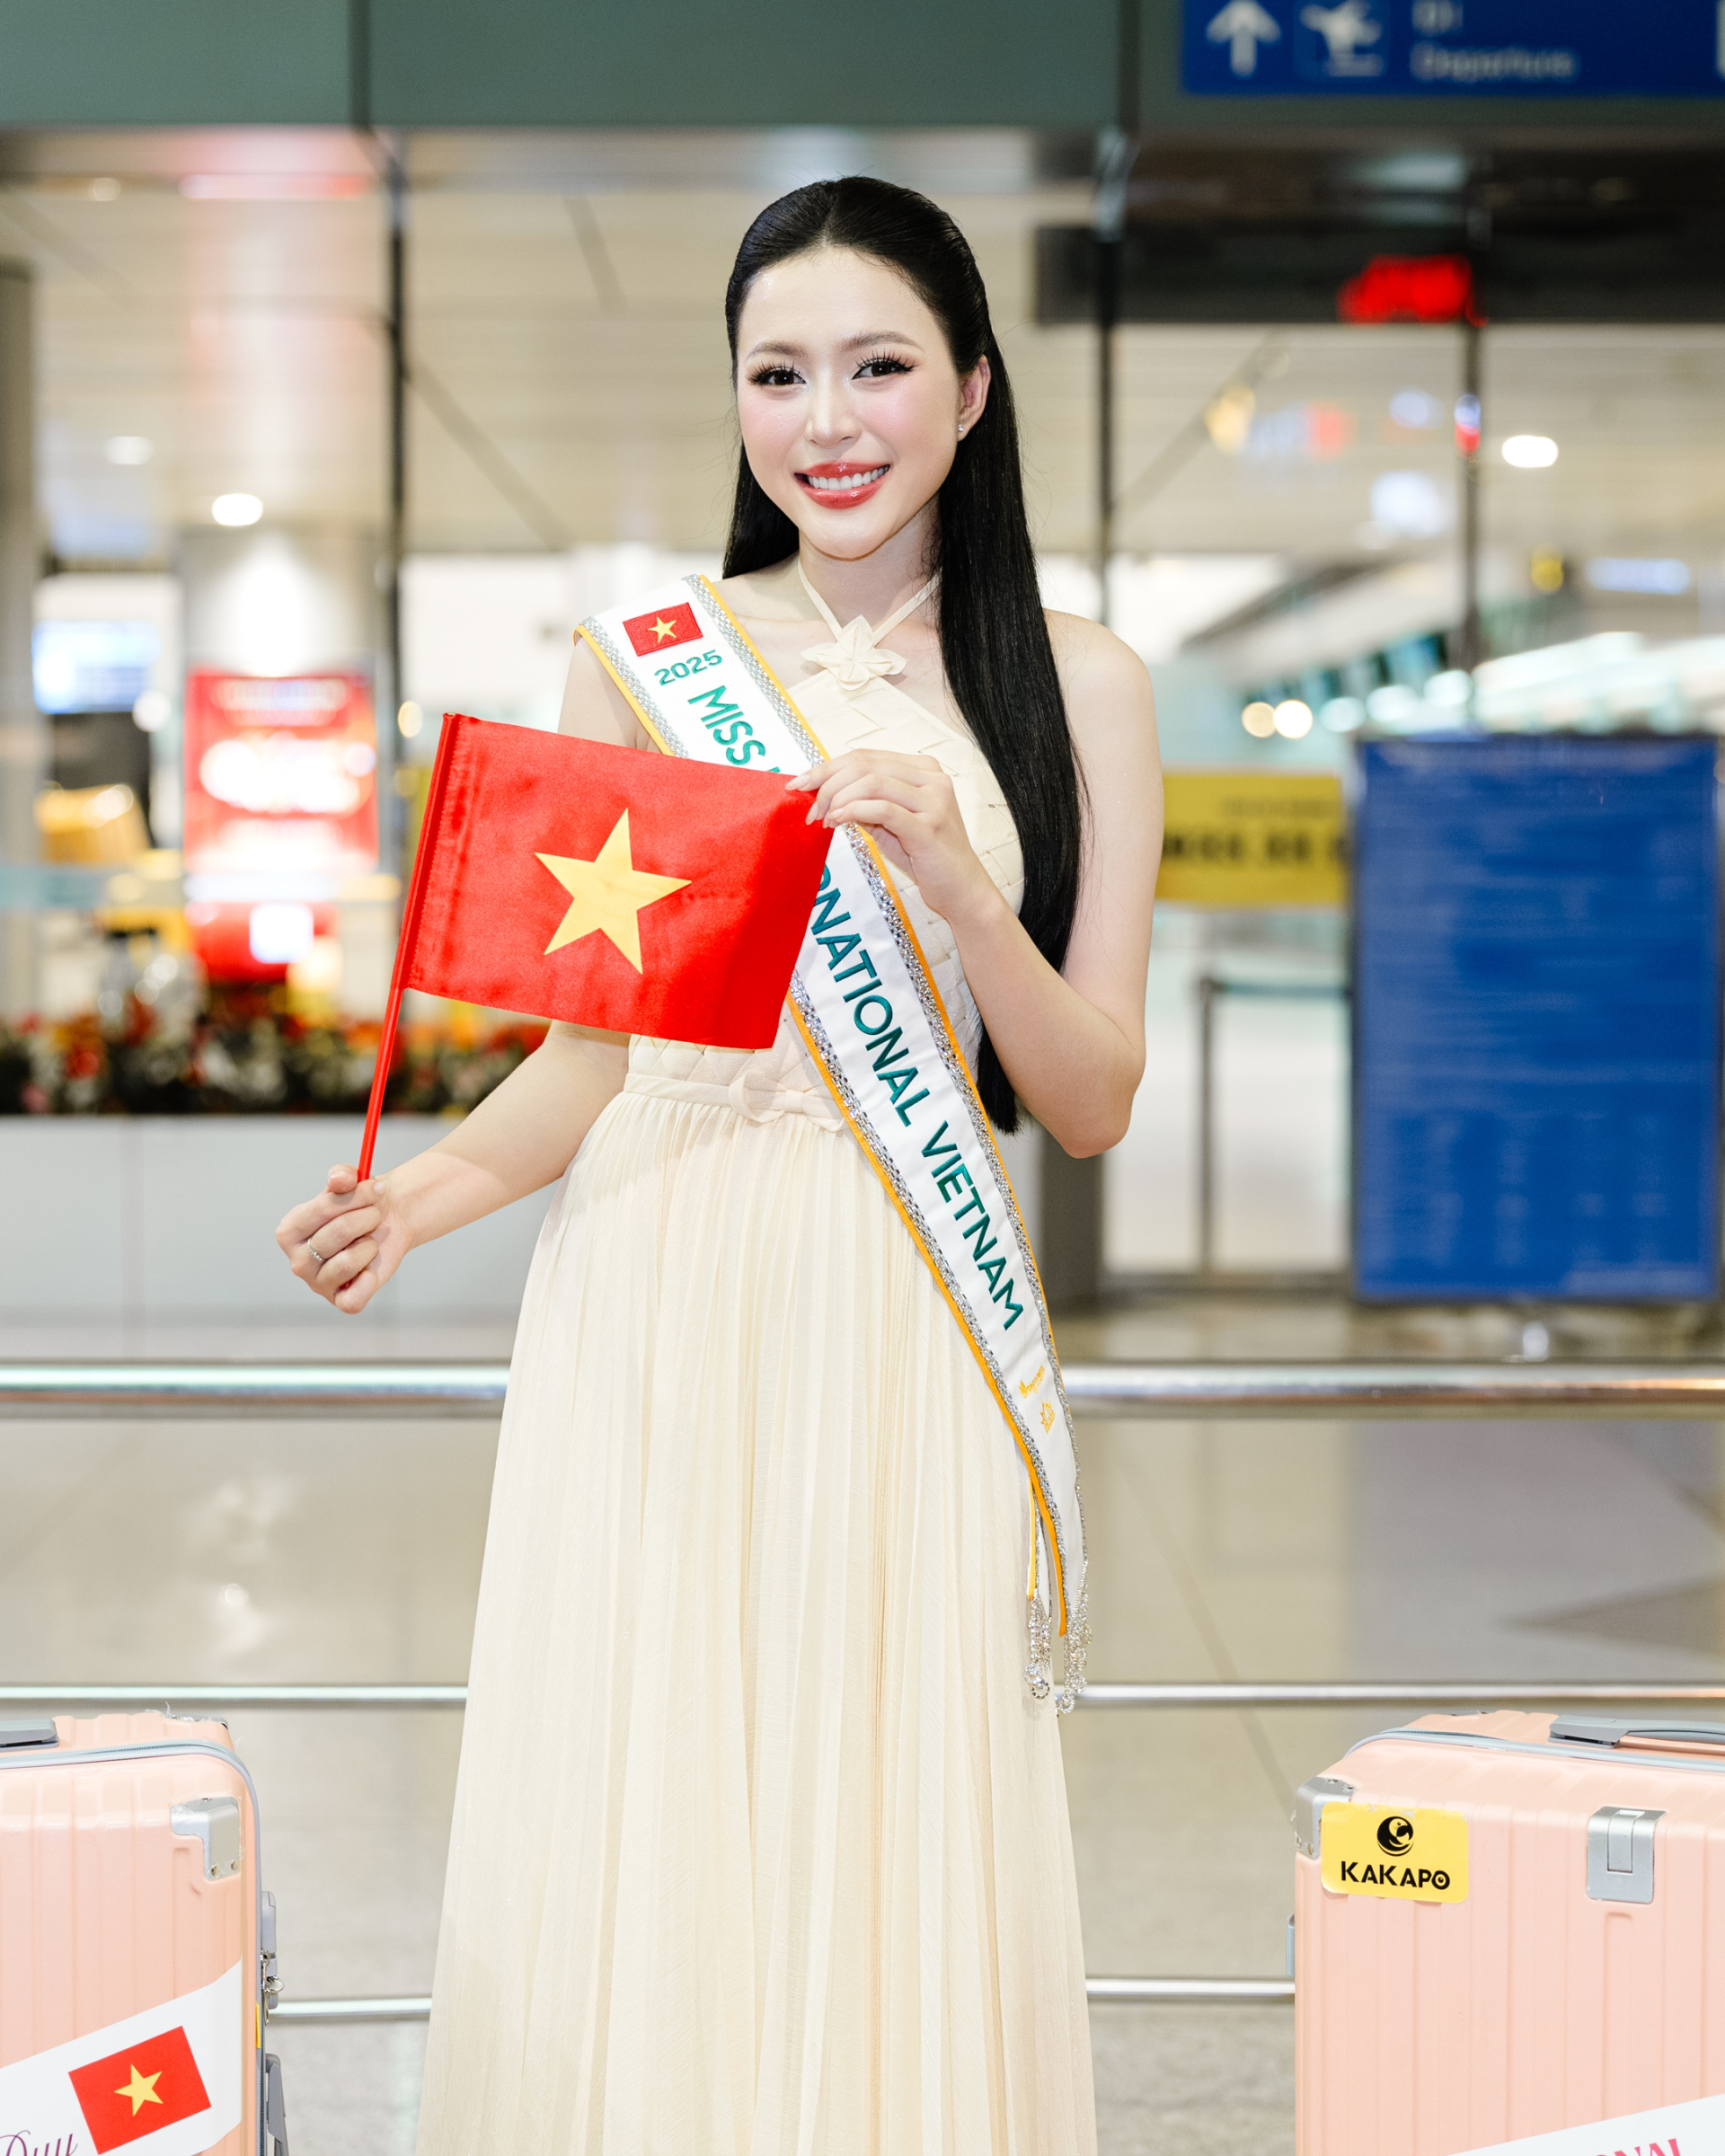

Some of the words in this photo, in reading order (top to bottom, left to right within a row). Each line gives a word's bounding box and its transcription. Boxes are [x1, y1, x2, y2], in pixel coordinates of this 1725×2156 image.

[654, 649, 723, 686] 2025
[688, 685, 766, 766] MISS
[922, 1120, 1024, 1330] VIETNAM
[1341, 1860, 1450, 1890] KAKAPO
